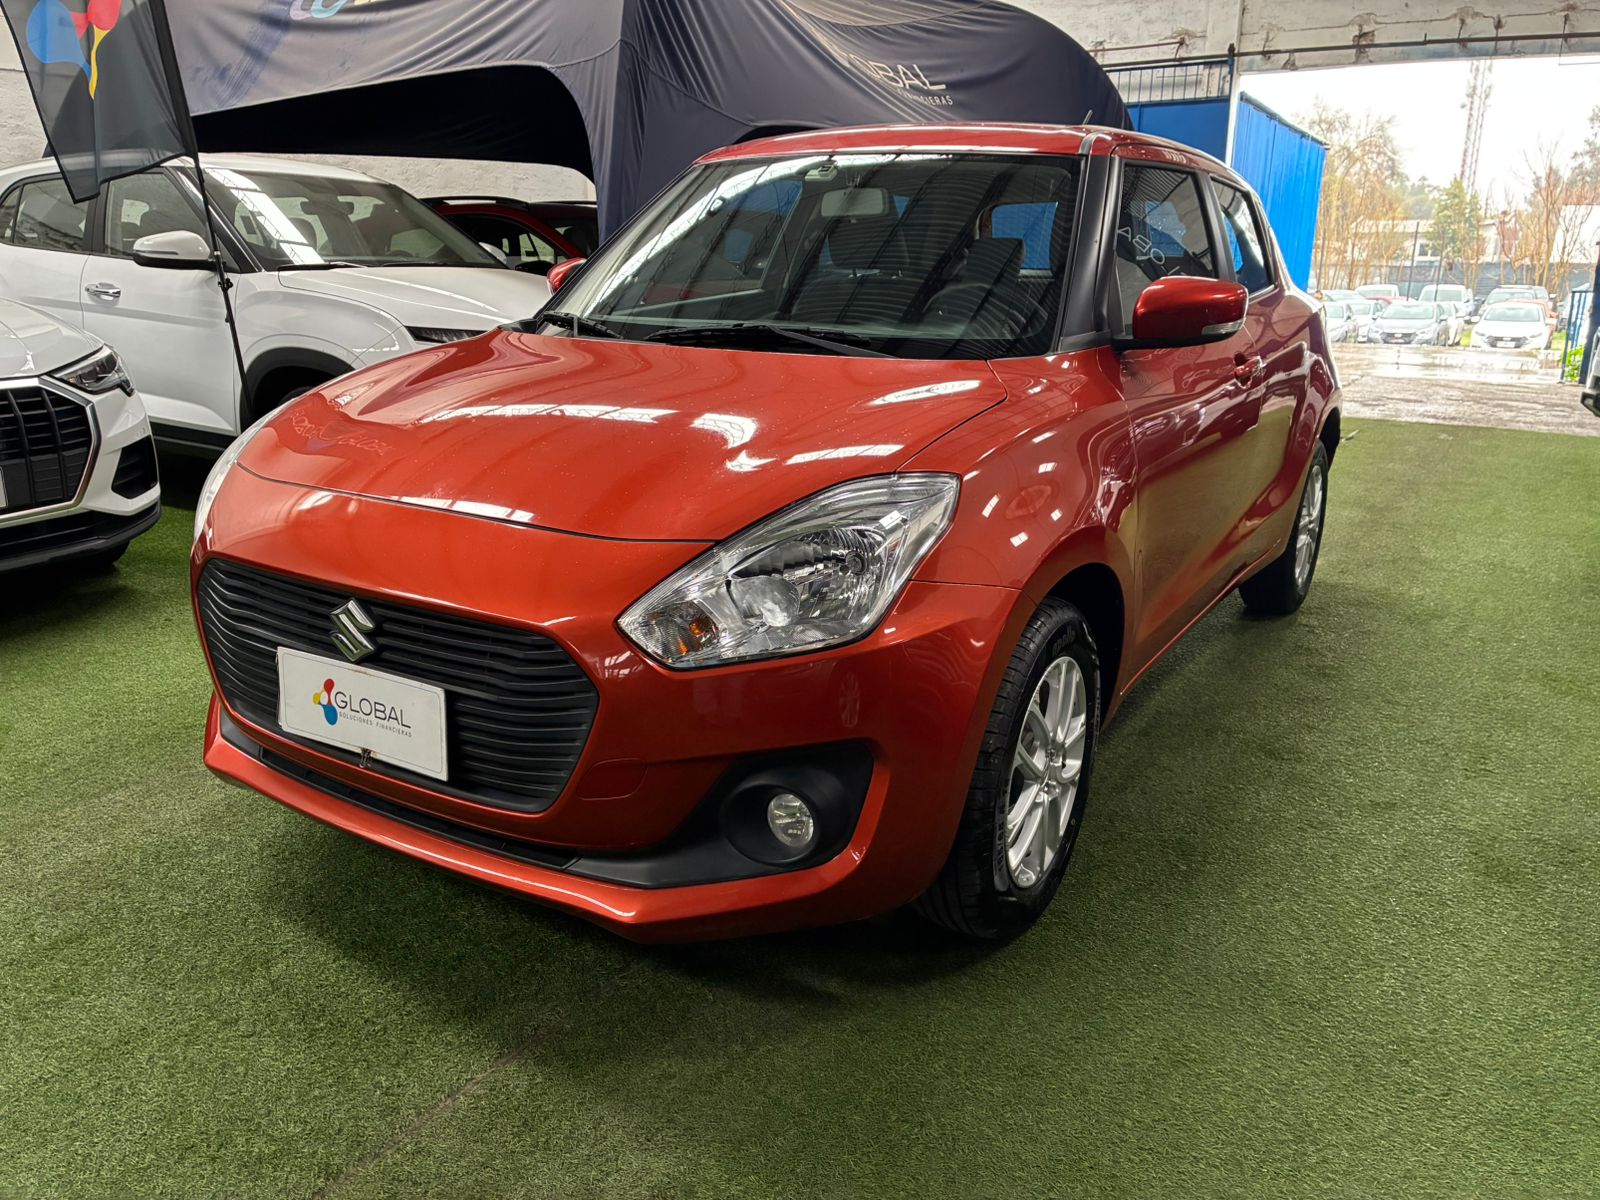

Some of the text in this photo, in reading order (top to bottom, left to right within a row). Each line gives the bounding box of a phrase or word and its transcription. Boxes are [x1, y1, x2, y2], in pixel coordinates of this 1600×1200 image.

[334, 691, 411, 729] GLOBAL
[339, 711, 412, 738] SOLUCIONES FINANCIERAS
